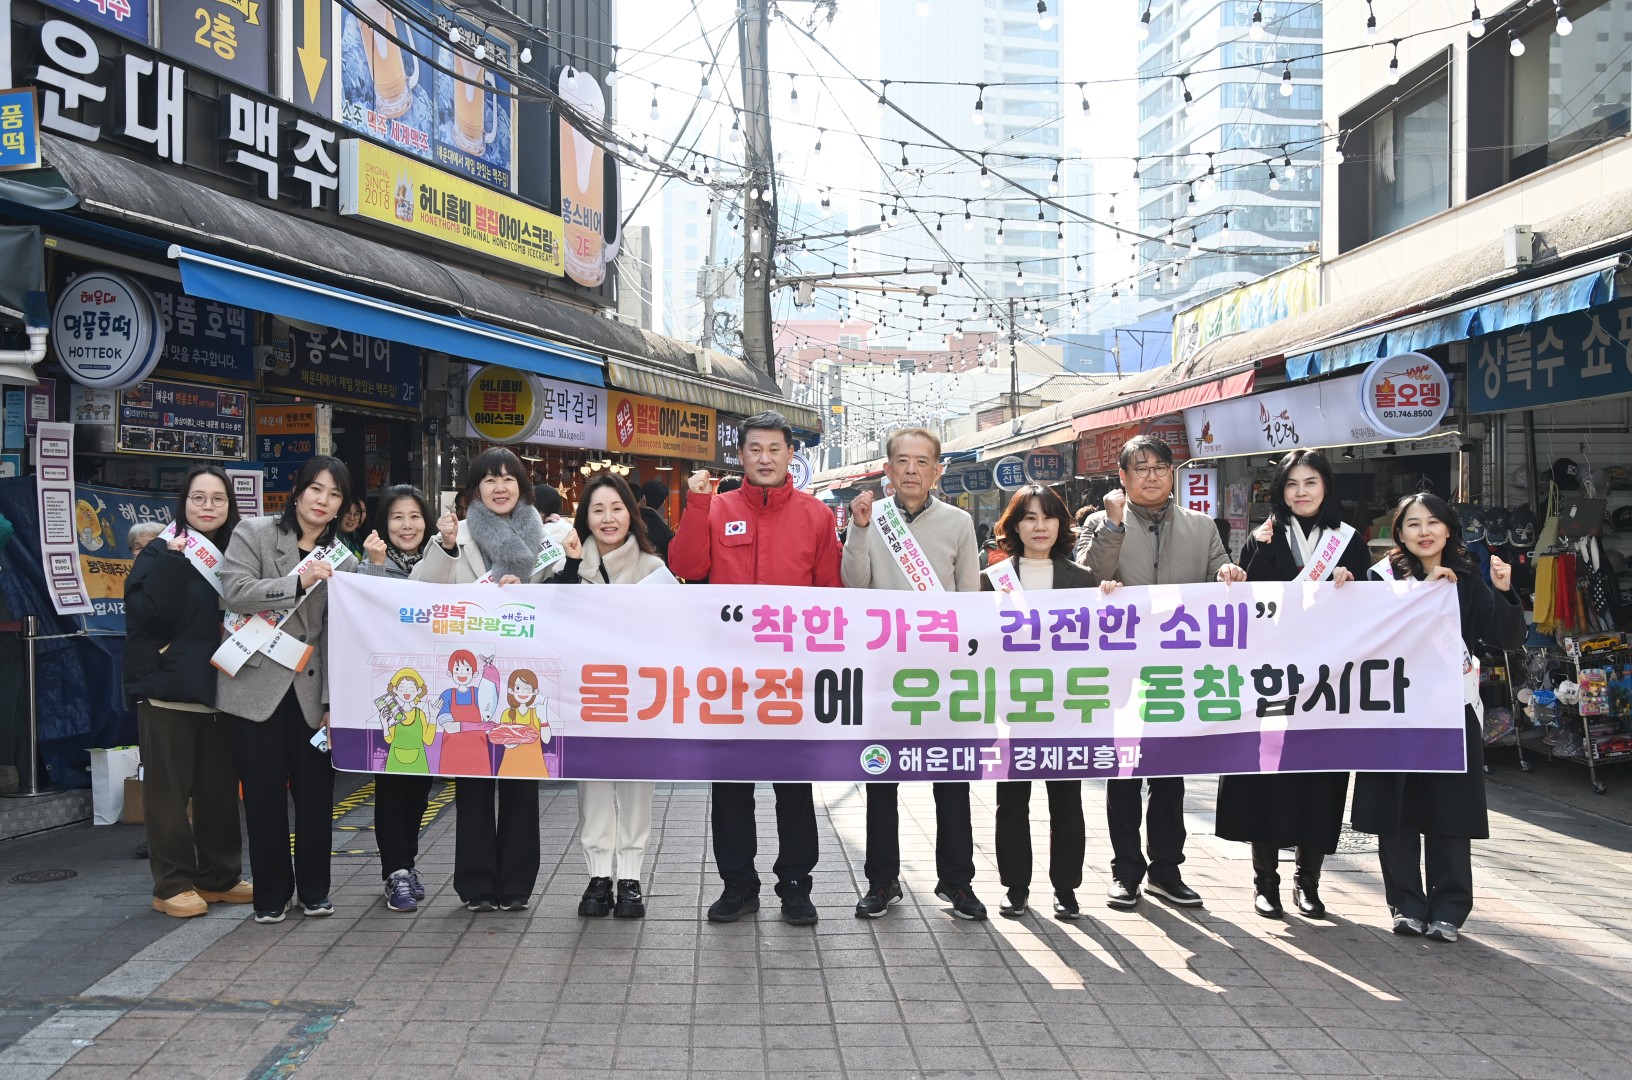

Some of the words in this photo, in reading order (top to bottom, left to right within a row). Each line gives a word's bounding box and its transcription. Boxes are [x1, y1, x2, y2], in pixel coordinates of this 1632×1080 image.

[195, 8, 238, 60] 2층
[341, 101, 363, 126] 소주
[367, 109, 388, 136] 맥주
[390, 119, 430, 153] 세계맥주
[228, 92, 338, 208] 맥주
[365, 162, 390, 179] ORIGINAL
[465, 157, 476, 175] 제일
[476, 162, 491, 182] 맛있는
[365, 173, 390, 194] SINCE
[365, 188, 390, 210] 2018
[420, 184, 471, 227] 허니홈비
[476, 204, 553, 253] 벌집아이스크림
[562, 197, 602, 235] 홍스비어
[463, 227, 490, 243] ORIGINAL
[493, 236, 526, 255] HONEYCOMB
[528, 248, 553, 264] ICECREAM
[576, 235, 590, 257] 2F
[81, 290, 116, 305] 해운대
[64, 311, 131, 341] 명품호떡
[204, 302, 246, 346] 호떡
[69, 347, 122, 359] HOTTEOK
[171, 345, 189, 363] 맛을
[192, 348, 238, 370] 추구합니다.
[1478, 329, 1566, 399] 상록수
[300, 369, 337, 388] 해운대에서
[339, 376, 353, 391] 제일
[355, 379, 375, 395] 맛있는
[402, 383, 415, 402] 2F
[1375, 380, 1441, 409] 불오뎅
[155, 390, 174, 404] 해운대
[483, 392, 517, 412] 벌집
[544, 387, 598, 427] 꿀막걸리
[259, 416, 284, 426] 해운대
[474, 413, 525, 426] 아이스크림
[616, 403, 630, 426] 부산
[637, 403, 709, 442] 벌집아이스크림
[1383, 409, 1434, 419] 051.746.8500
[636, 437, 662, 450] Honeycomb
[717, 421, 739, 450] 타코야
[1003, 465, 1022, 475] 조은
[1034, 457, 1059, 469] 비취
[883, 501, 906, 537] 시장에서
[195, 546, 218, 568] 명절
[877, 515, 902, 553] 전통시장
[900, 553, 927, 592] 살리GO
[865, 608, 980, 656] 가격,
[1000, 602, 1141, 653] 건전한
[579, 664, 864, 728] 물가안정에
[891, 665, 1110, 726] 우리모두
[1138, 656, 1411, 723] 동참합시다
[898, 745, 1003, 773] 해운대구
[1013, 743, 1144, 772] 경제진흥과
